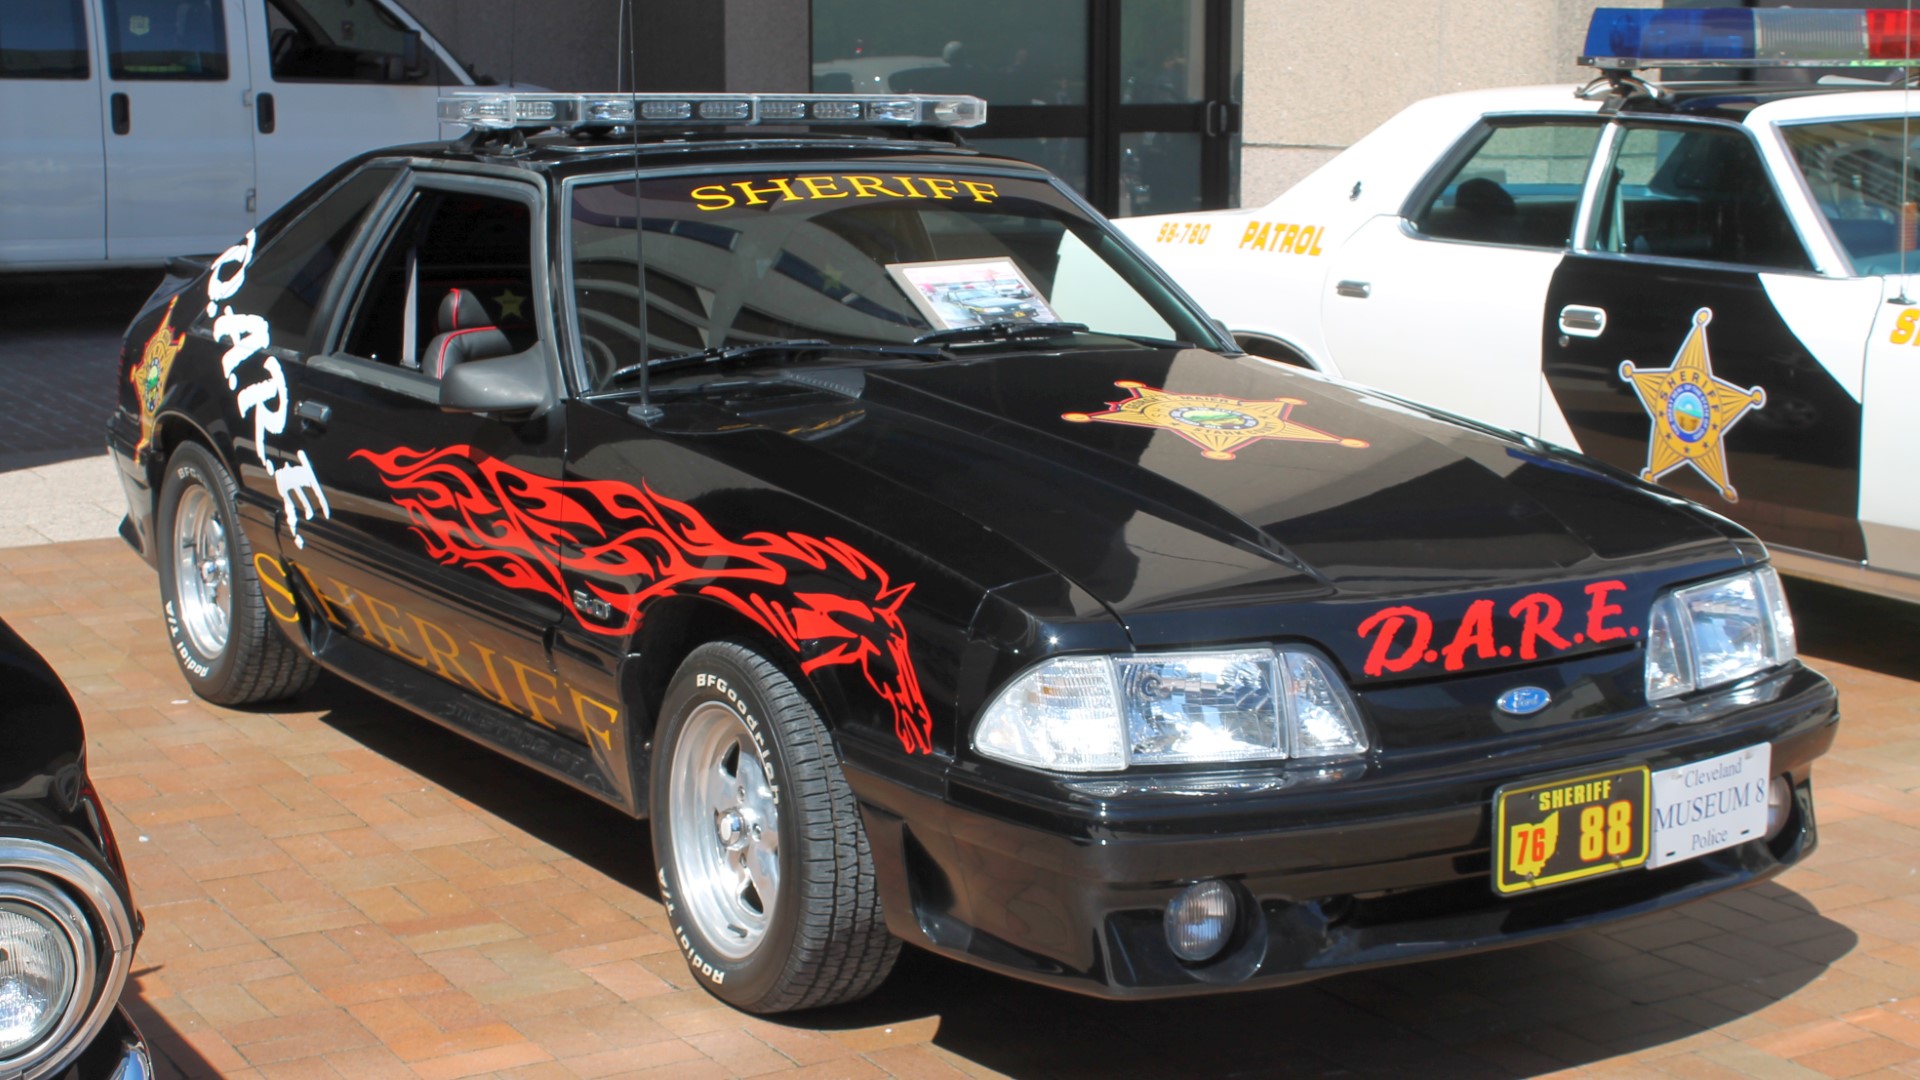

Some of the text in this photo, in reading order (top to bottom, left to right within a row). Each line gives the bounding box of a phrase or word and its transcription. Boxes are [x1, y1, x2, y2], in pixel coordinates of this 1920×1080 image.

[690, 175, 999, 211] SHERIFF
[1238, 220, 1325, 256] PATROL
[1889, 307, 1920, 346] S
[1659, 371, 1720, 412] SHERIFF
[1357, 580, 1639, 677] D.A.R.E.
[254, 553, 618, 766] SHERIFF
[696, 673, 779, 805] BFGoodrich
[1684, 757, 1742, 788] Cleveland
[1539, 780, 1611, 811] SHERIFF
[1654, 777, 1765, 833] MUSEUM 8
[1517, 800, 1632, 866] 76 88
[1691, 828, 1728, 851] Police
[658, 867, 725, 985] Radial T/A
